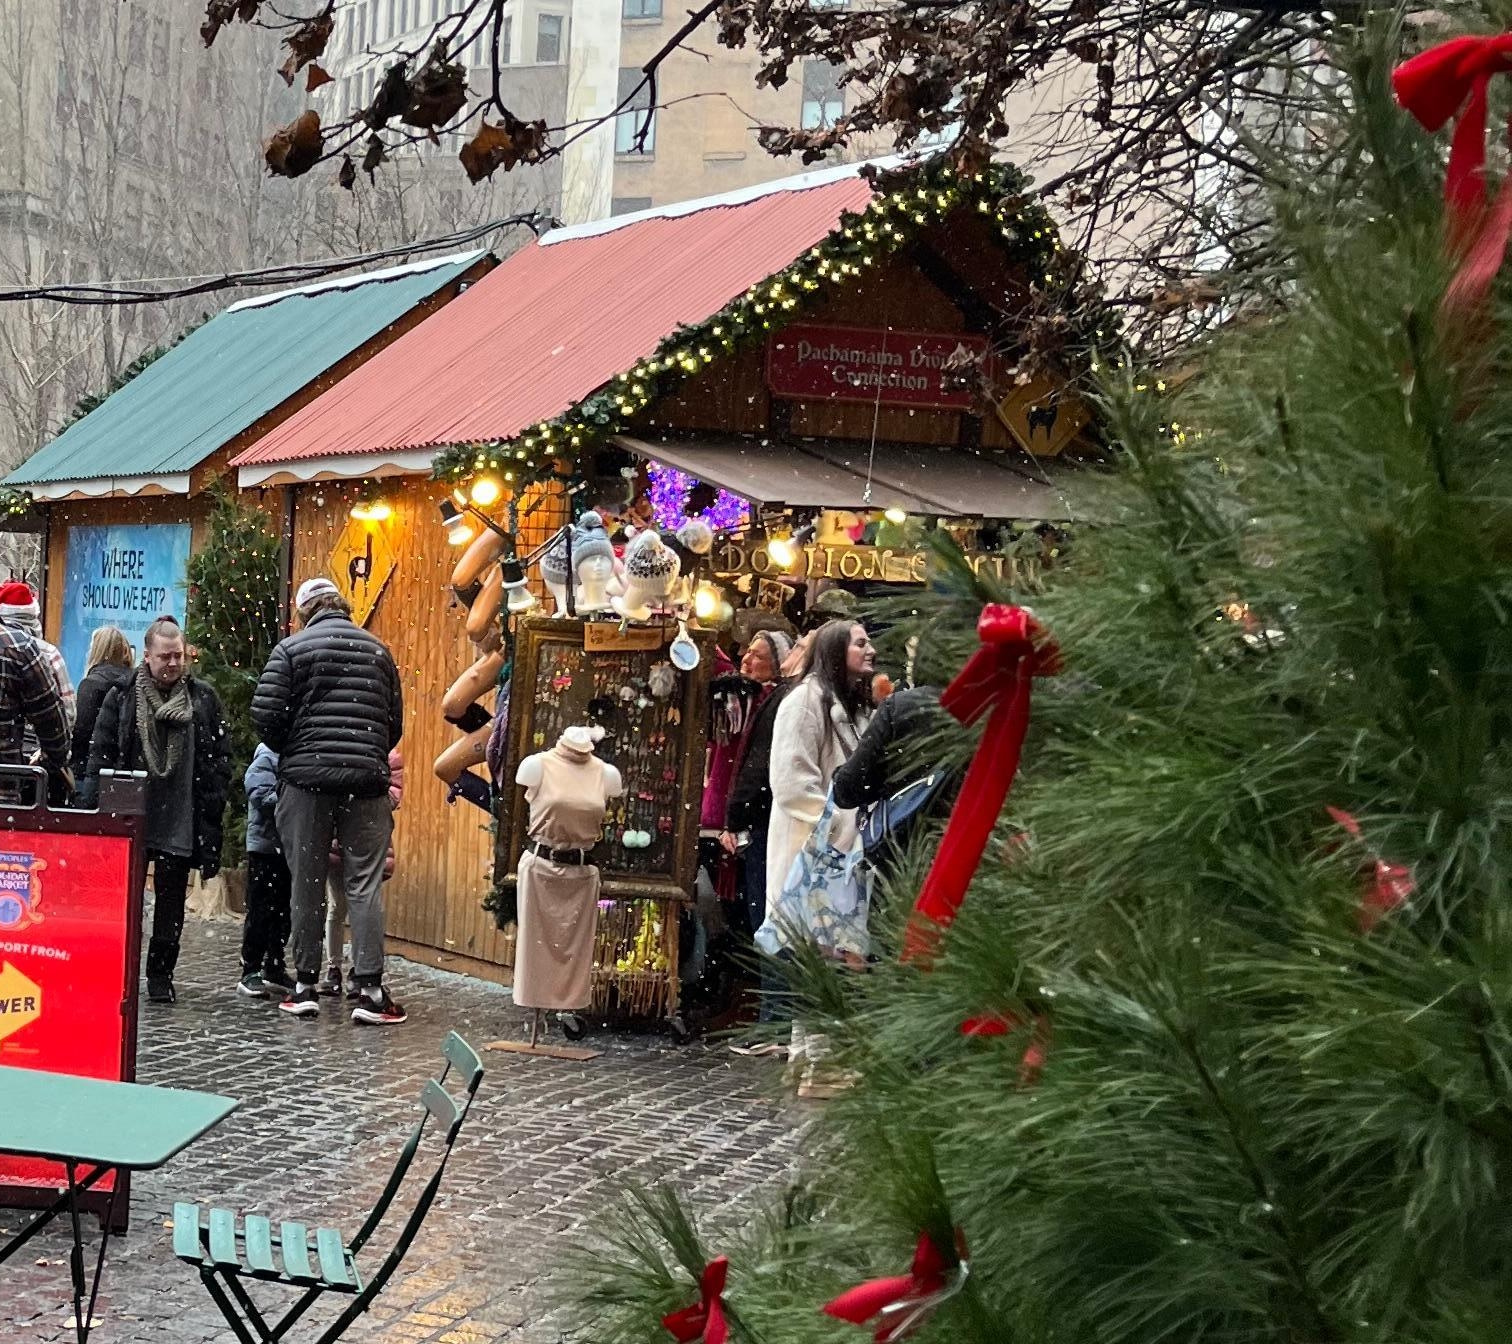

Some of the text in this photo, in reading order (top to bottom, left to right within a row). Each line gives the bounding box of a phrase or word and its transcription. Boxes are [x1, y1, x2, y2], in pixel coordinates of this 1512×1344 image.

[832, 364, 929, 390] Connection
[102, 548, 145, 579] WHERE
[82, 582, 166, 612] SHOULD WE EAT?
[31, 945, 71, 961] FROM:
